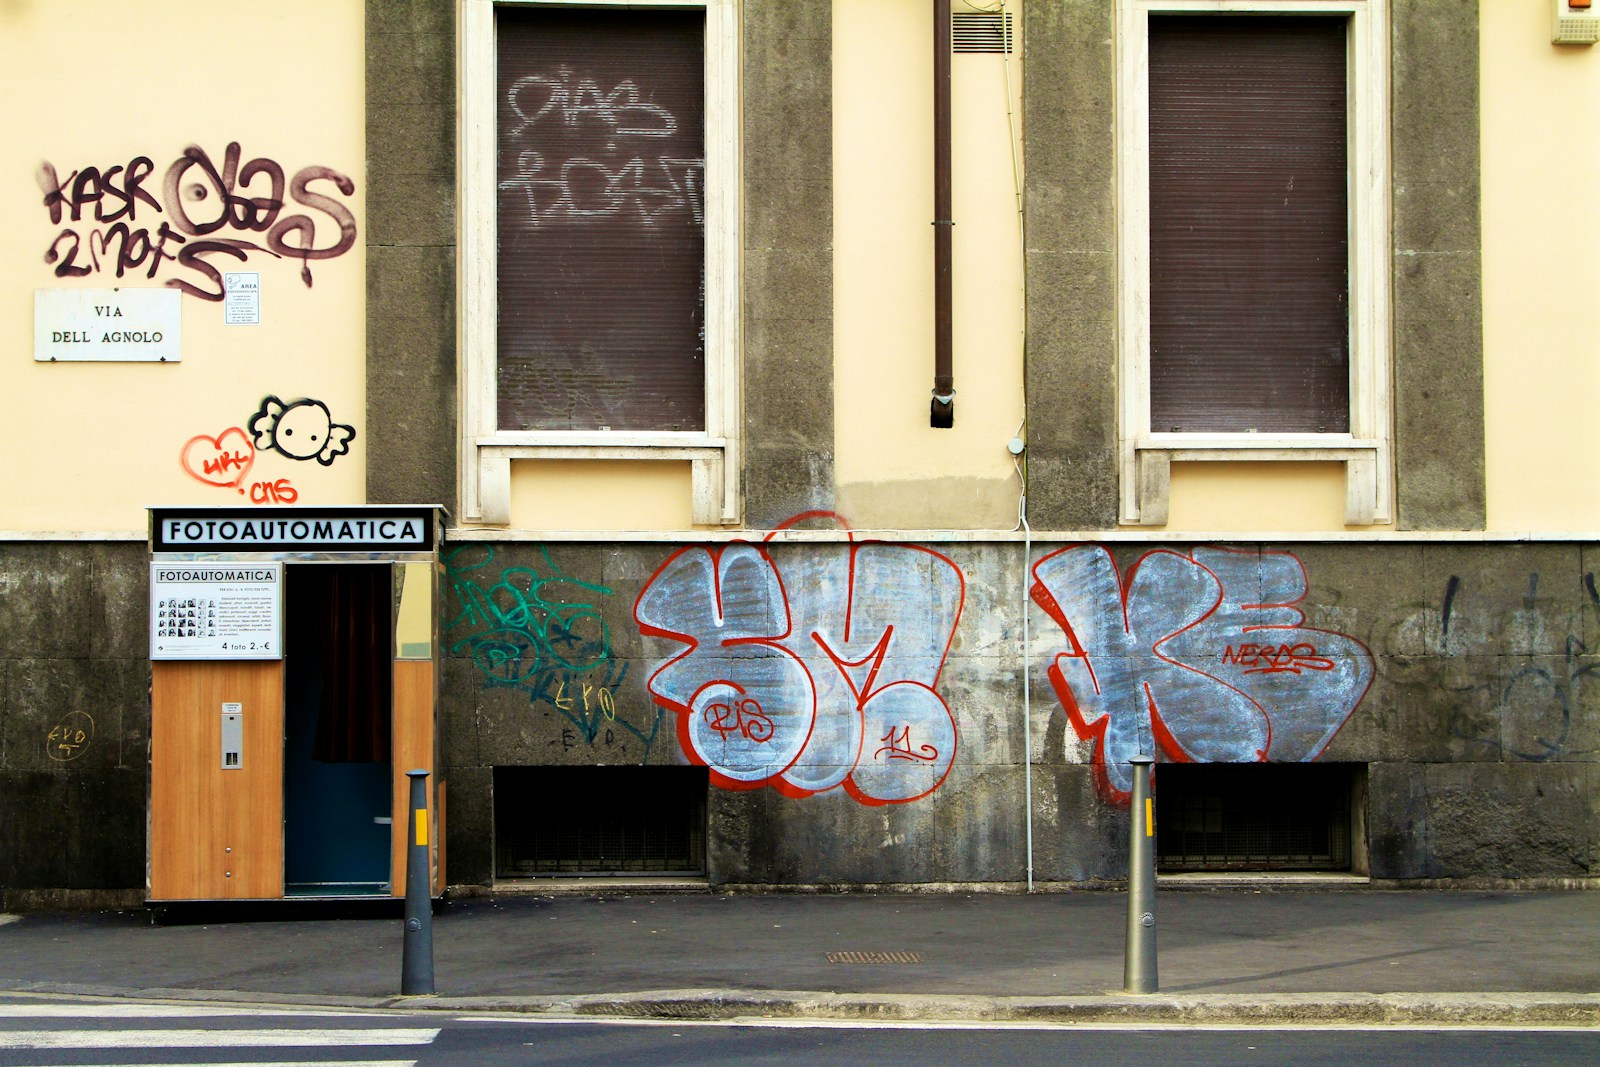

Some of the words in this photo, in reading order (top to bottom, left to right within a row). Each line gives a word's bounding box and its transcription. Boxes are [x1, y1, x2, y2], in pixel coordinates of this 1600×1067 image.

[94, 306, 123, 317] VIA
[52, 331, 91, 343] DELL
[102, 331, 164, 343] AGNOLO
[170, 520, 417, 540] FOTOAUTOMATICA
[160, 570, 273, 581] FOTOAUTOMATICA
[222, 642, 228, 650] 4
